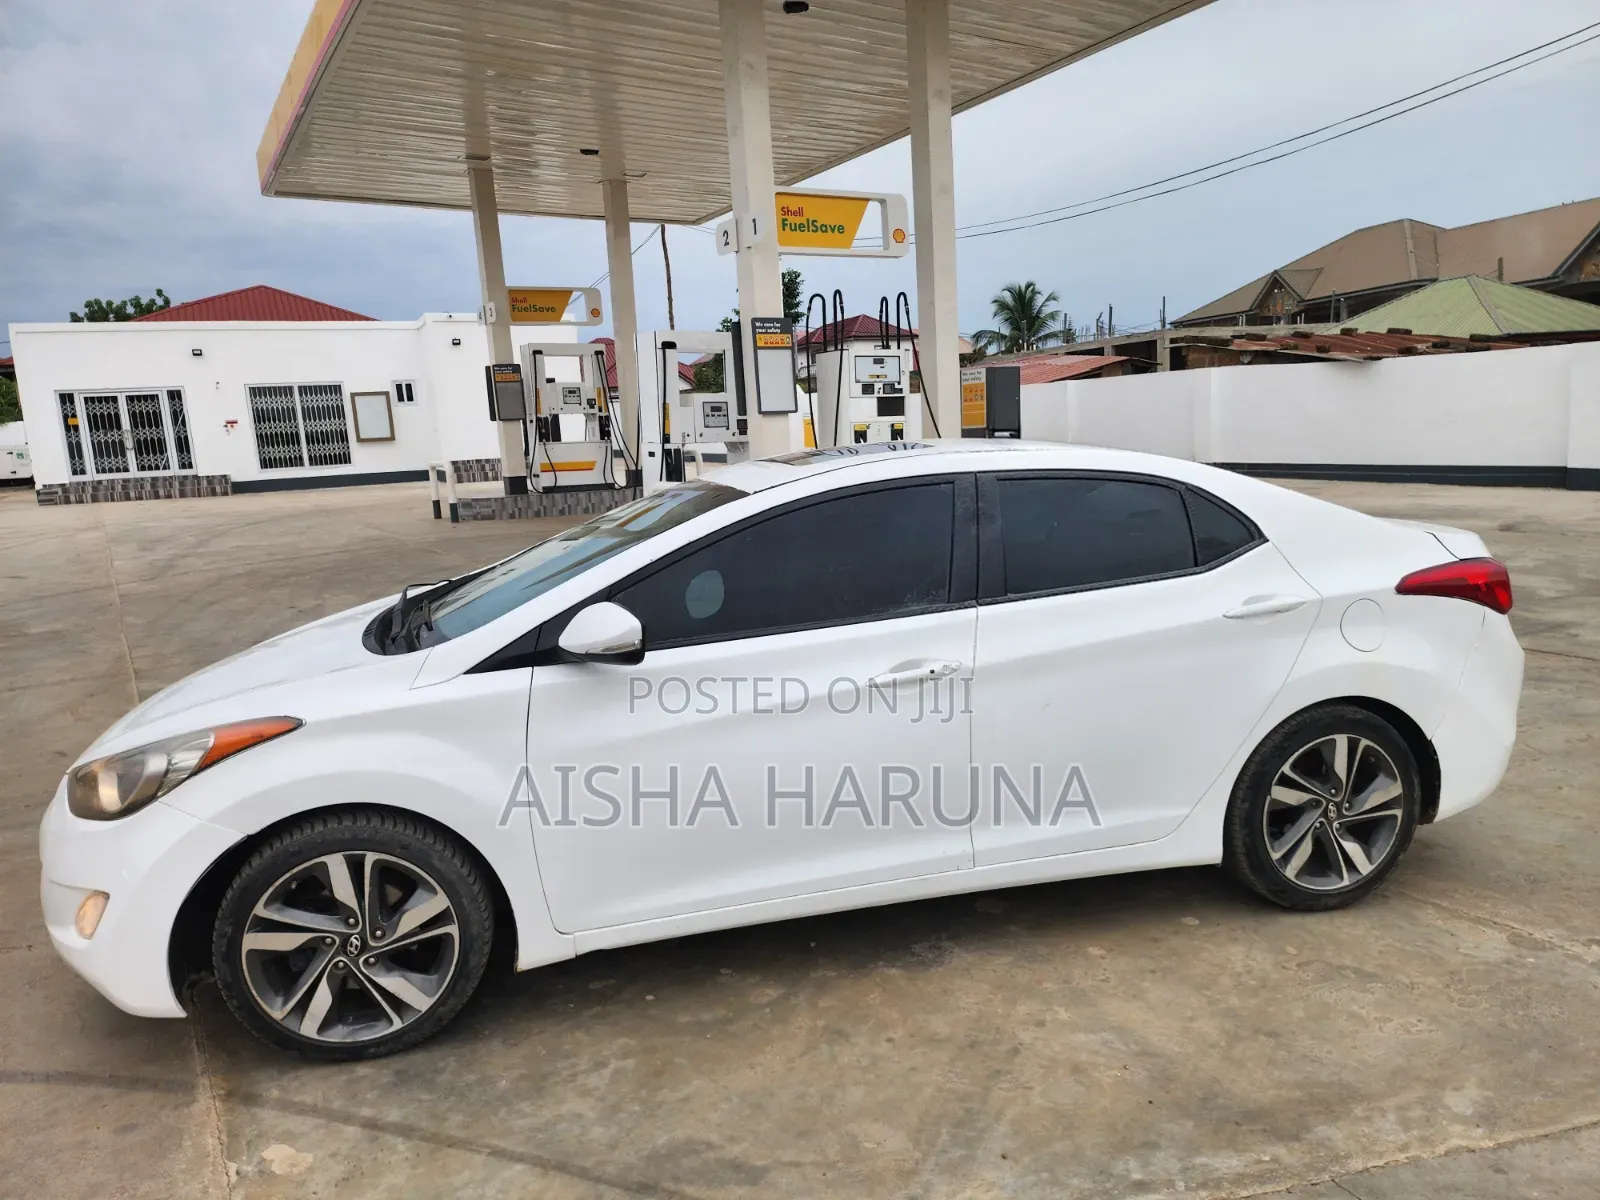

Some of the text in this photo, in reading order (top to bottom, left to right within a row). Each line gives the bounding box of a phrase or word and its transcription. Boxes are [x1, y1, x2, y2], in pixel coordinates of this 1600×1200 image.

[780, 206, 804, 217] Shell
[752, 218, 757, 235] 1
[781, 218, 845, 234] FuelSave
[722, 230, 729, 247] 2
[512, 304, 556, 313] FuelSave
